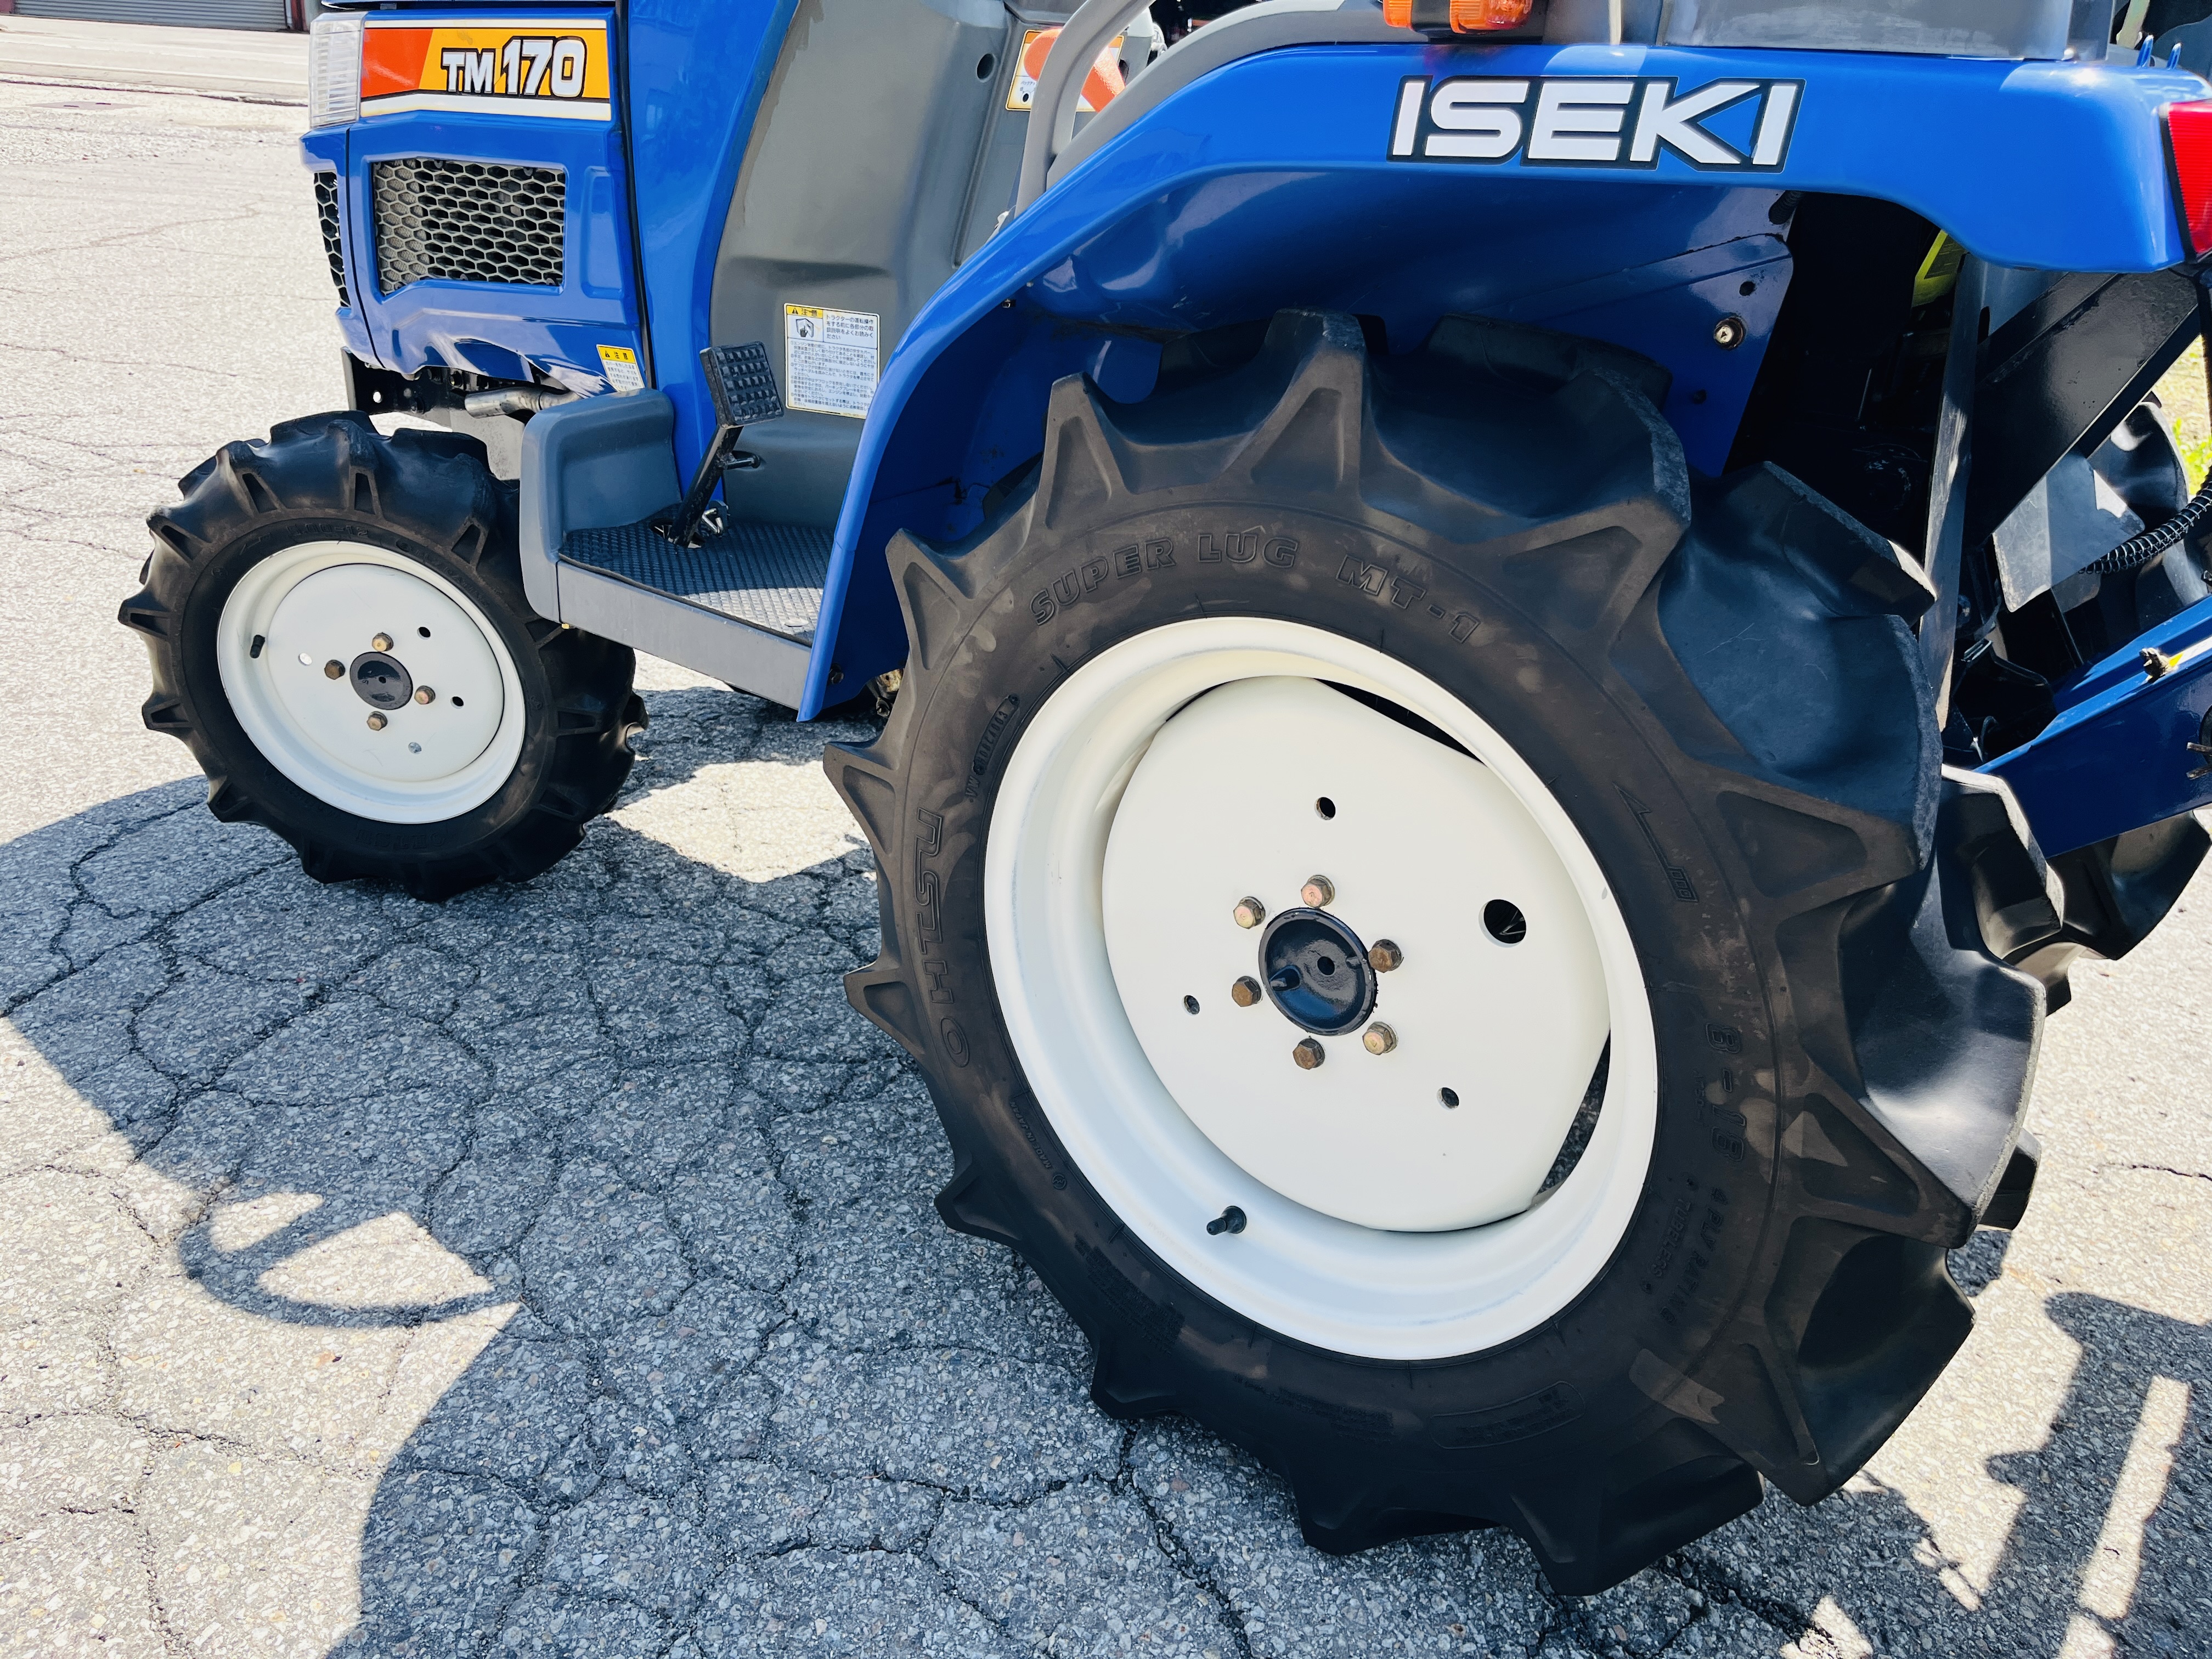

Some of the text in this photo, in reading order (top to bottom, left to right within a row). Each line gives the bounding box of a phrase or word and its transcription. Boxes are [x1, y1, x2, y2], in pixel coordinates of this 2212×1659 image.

[441, 36, 586, 97] TM170
[1390, 77, 1800, 169] ISEKI
[801, 307, 817, 317] 注意
[1029, 533, 1483, 644] SUPER LUG MT-1
[913, 807, 970, 1069] OHTSU
[1010, 1101, 1053, 1169] MADE IN JAPAN
[1651, 1198, 1692, 1278] TUBELESS
[1659, 1186, 1729, 1324] 4 PLY RATING
